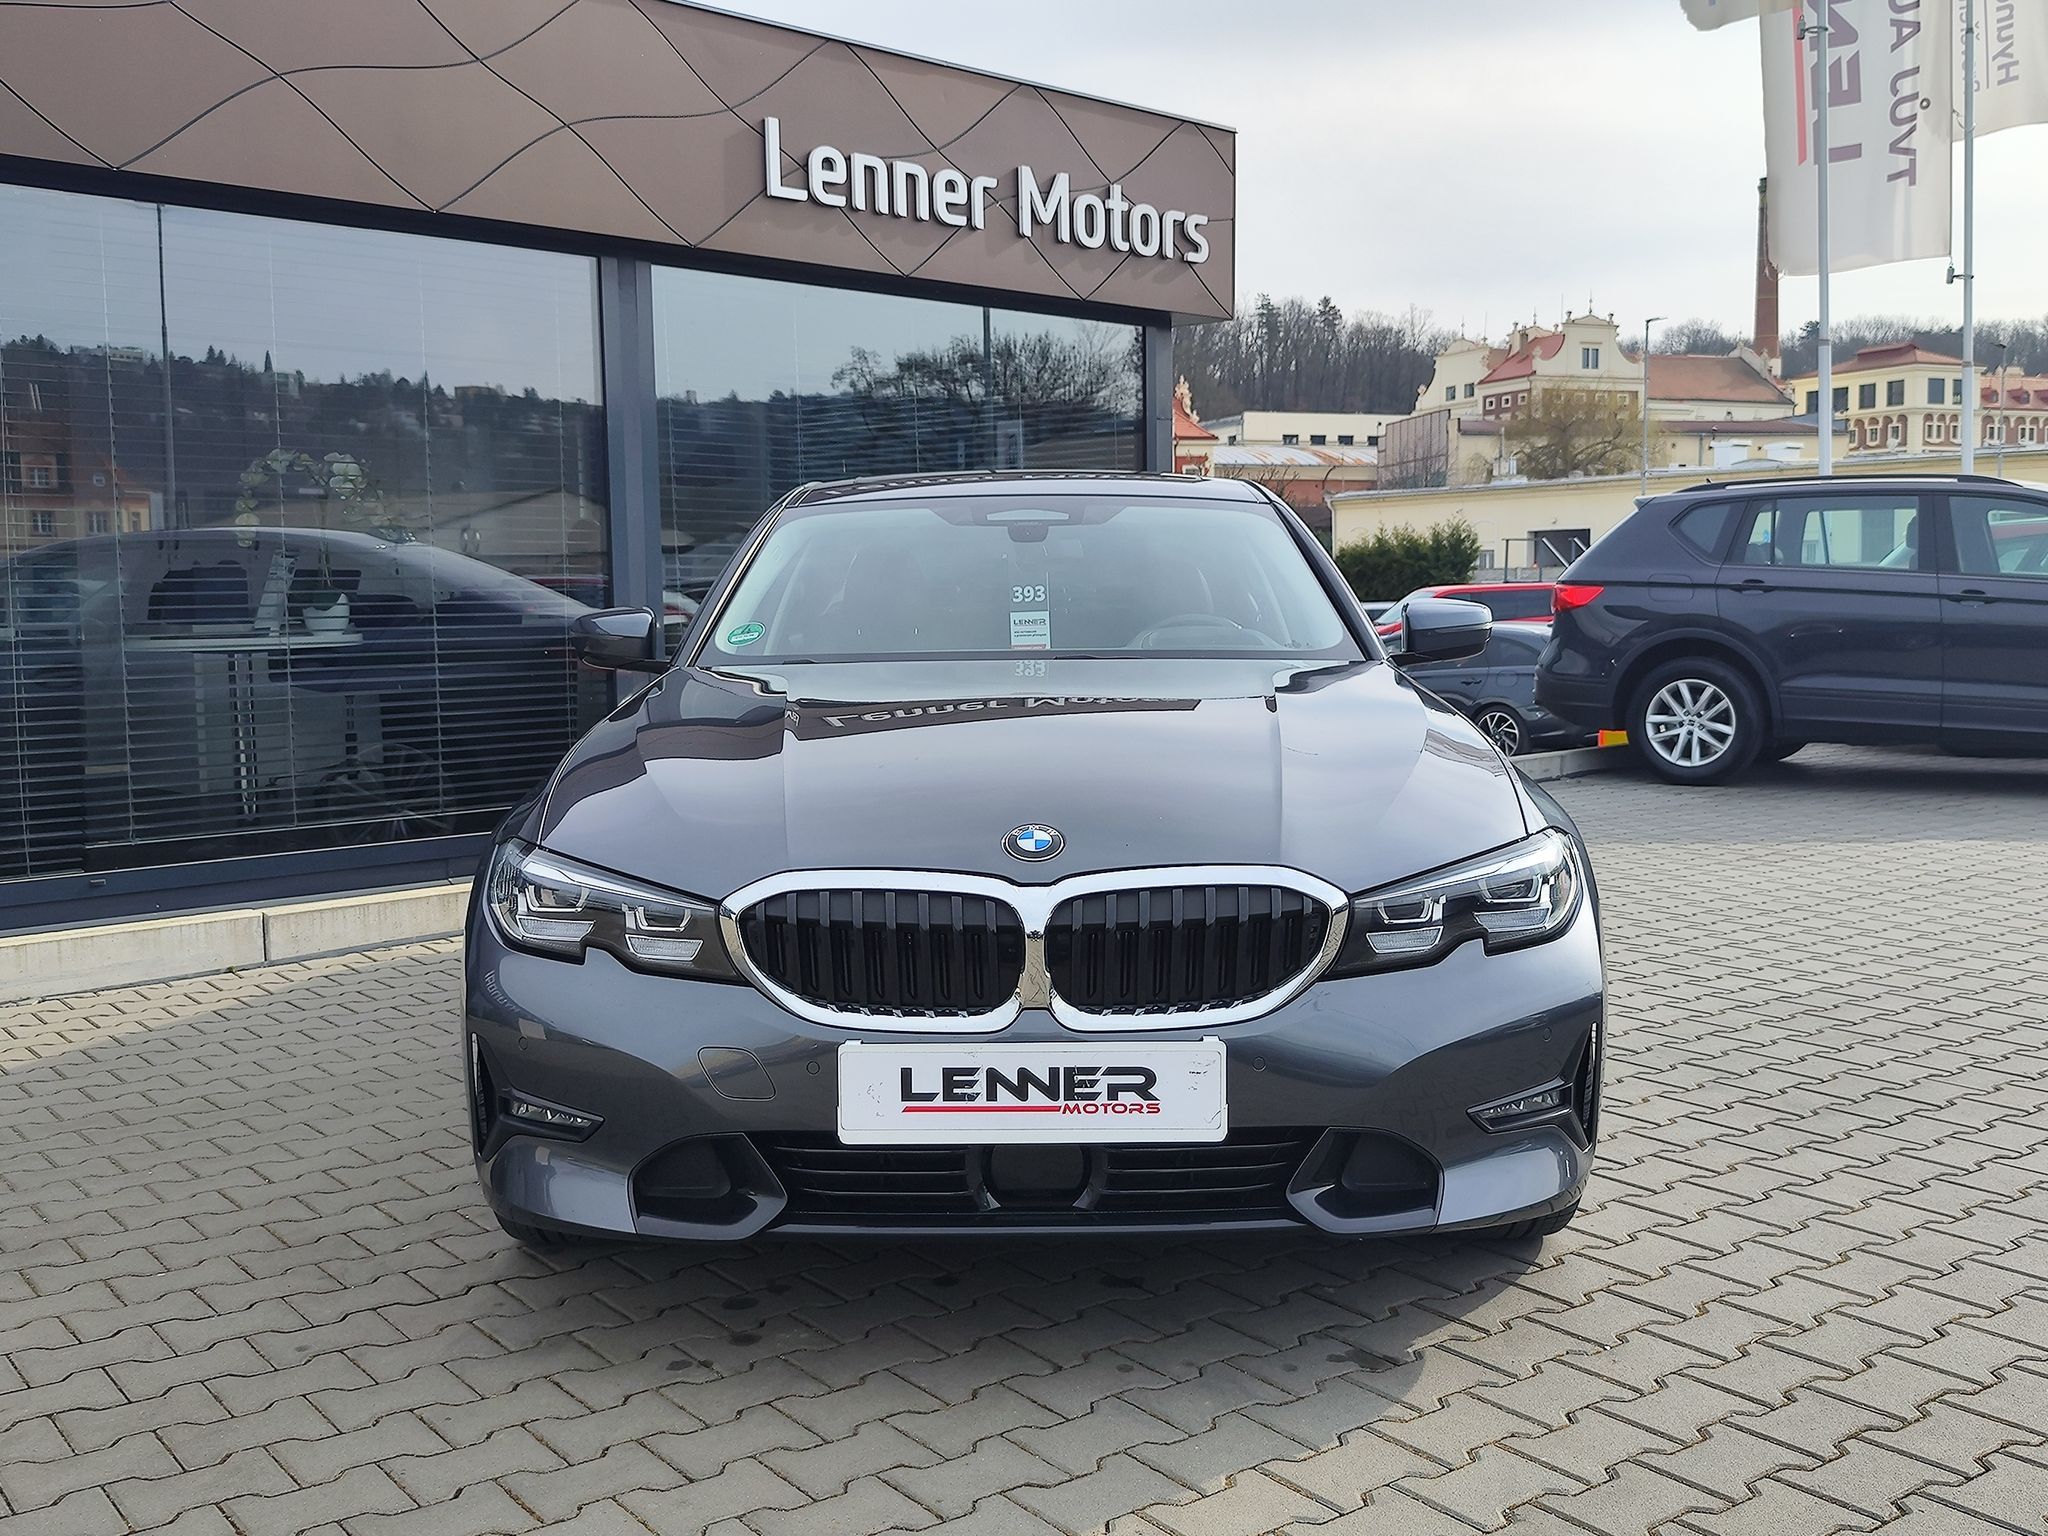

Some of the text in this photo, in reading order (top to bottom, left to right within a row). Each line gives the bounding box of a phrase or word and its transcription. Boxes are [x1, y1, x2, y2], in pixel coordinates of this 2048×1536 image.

[765, 117, 1210, 263] Lenner Motors
[1012, 585, 1046, 603] 393
[901, 1067, 1160, 1101] LENNER
[1062, 1102, 1161, 1115] MOTORS
